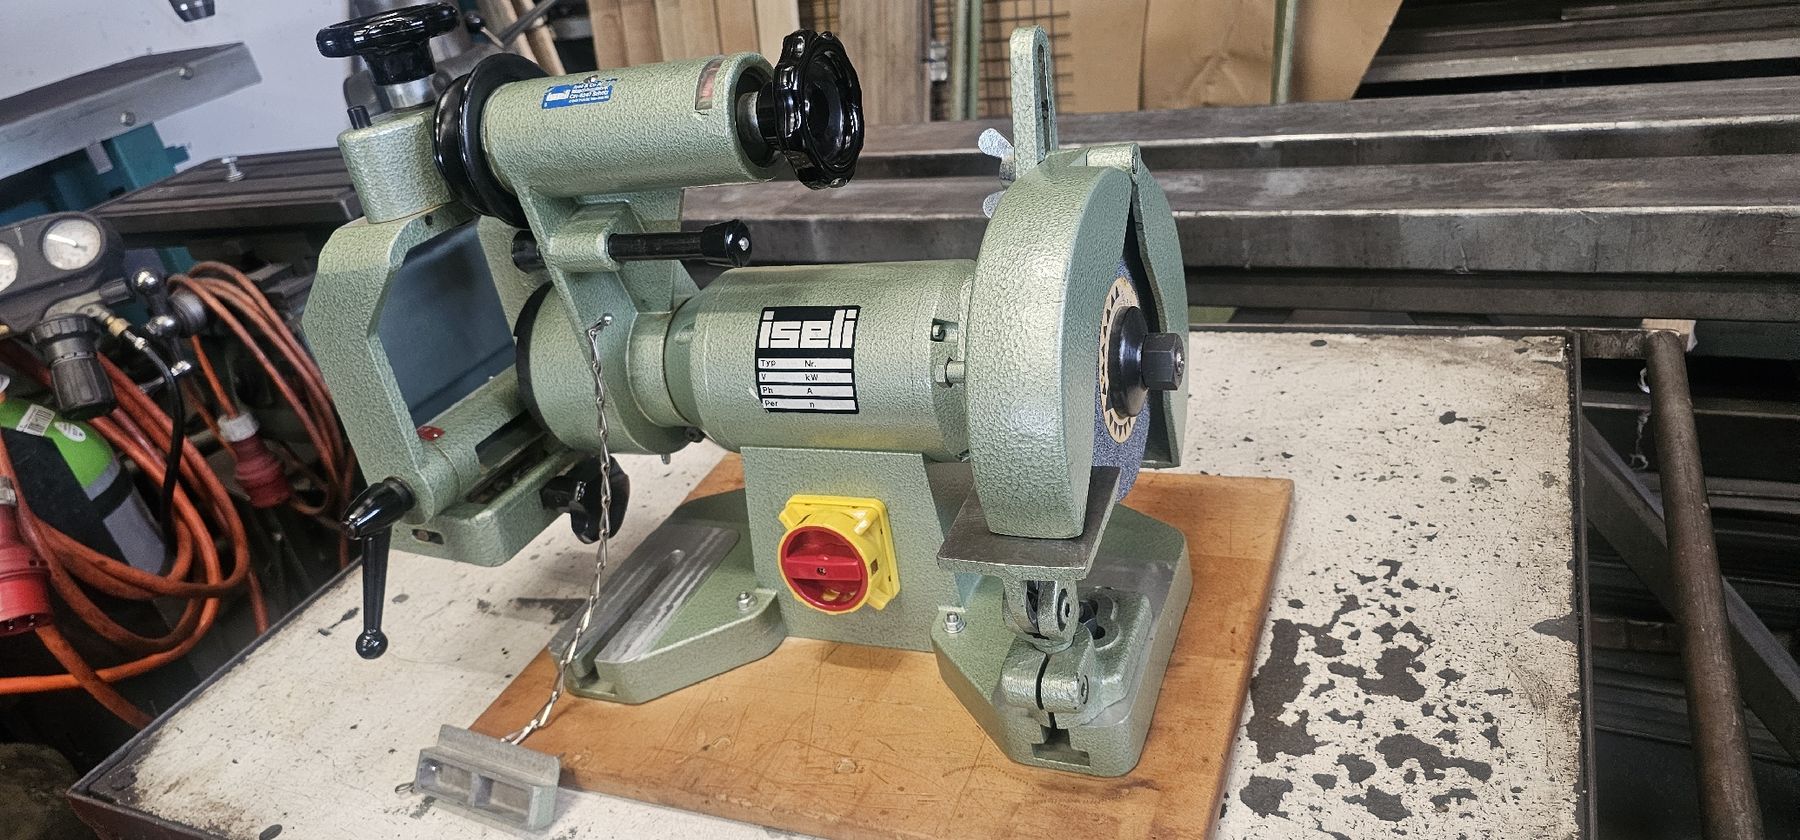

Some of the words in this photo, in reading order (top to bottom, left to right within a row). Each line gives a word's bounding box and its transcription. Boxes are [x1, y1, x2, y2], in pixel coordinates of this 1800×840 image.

[758, 309, 858, 349] iseli
[760, 359, 777, 367] Typ
[804, 360, 817, 368] Nr.
[805, 373, 819, 381] kW
[762, 386, 774, 394] Ph
[806, 387, 813, 395] A
